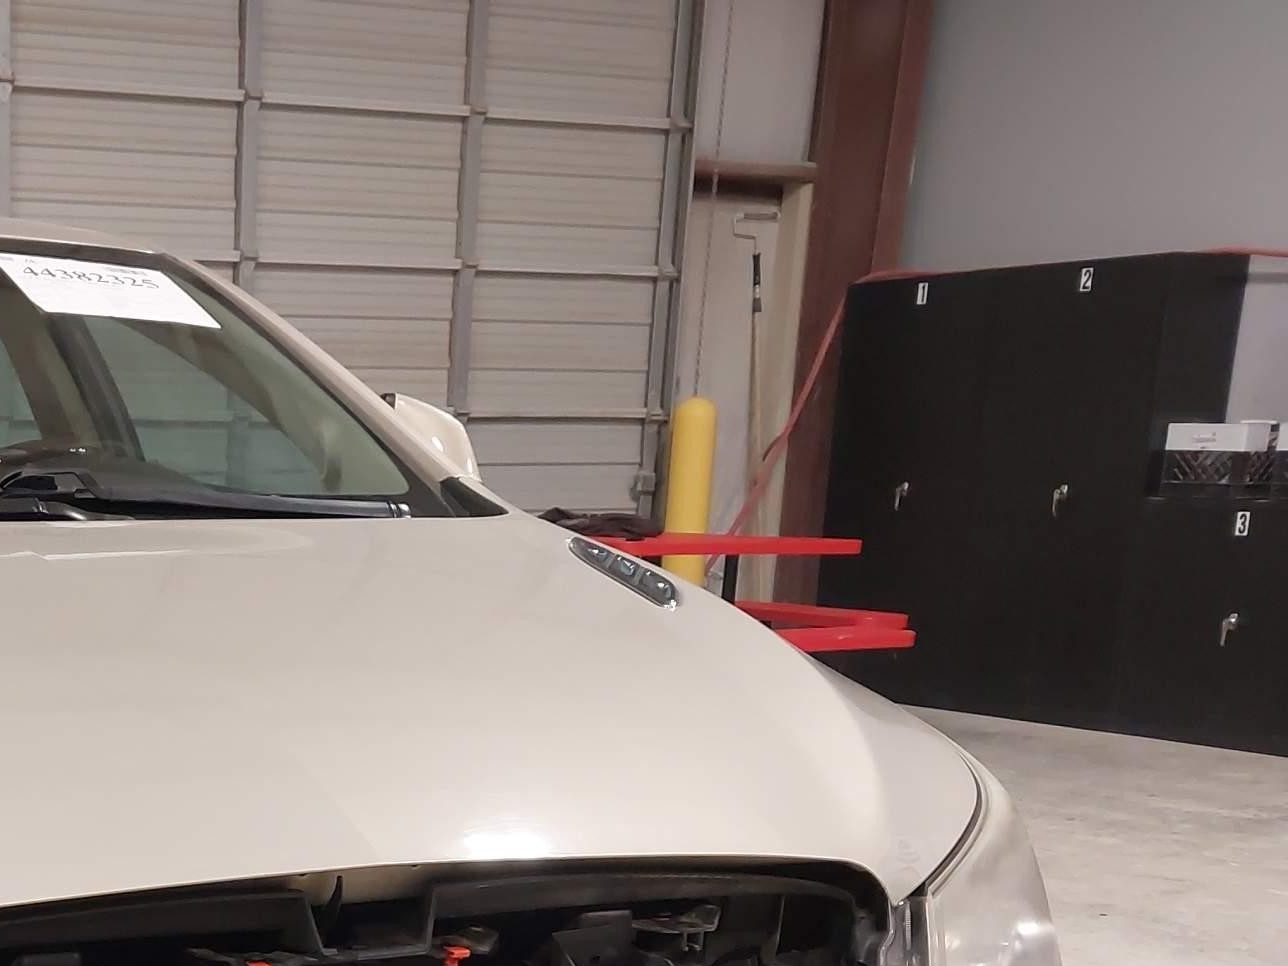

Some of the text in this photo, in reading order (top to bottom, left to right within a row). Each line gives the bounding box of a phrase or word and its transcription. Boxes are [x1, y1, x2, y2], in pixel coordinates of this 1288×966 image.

[22, 265, 160, 289] 44382325
[1082, 268, 1093, 290] 2
[1237, 512, 1248, 534] 3
